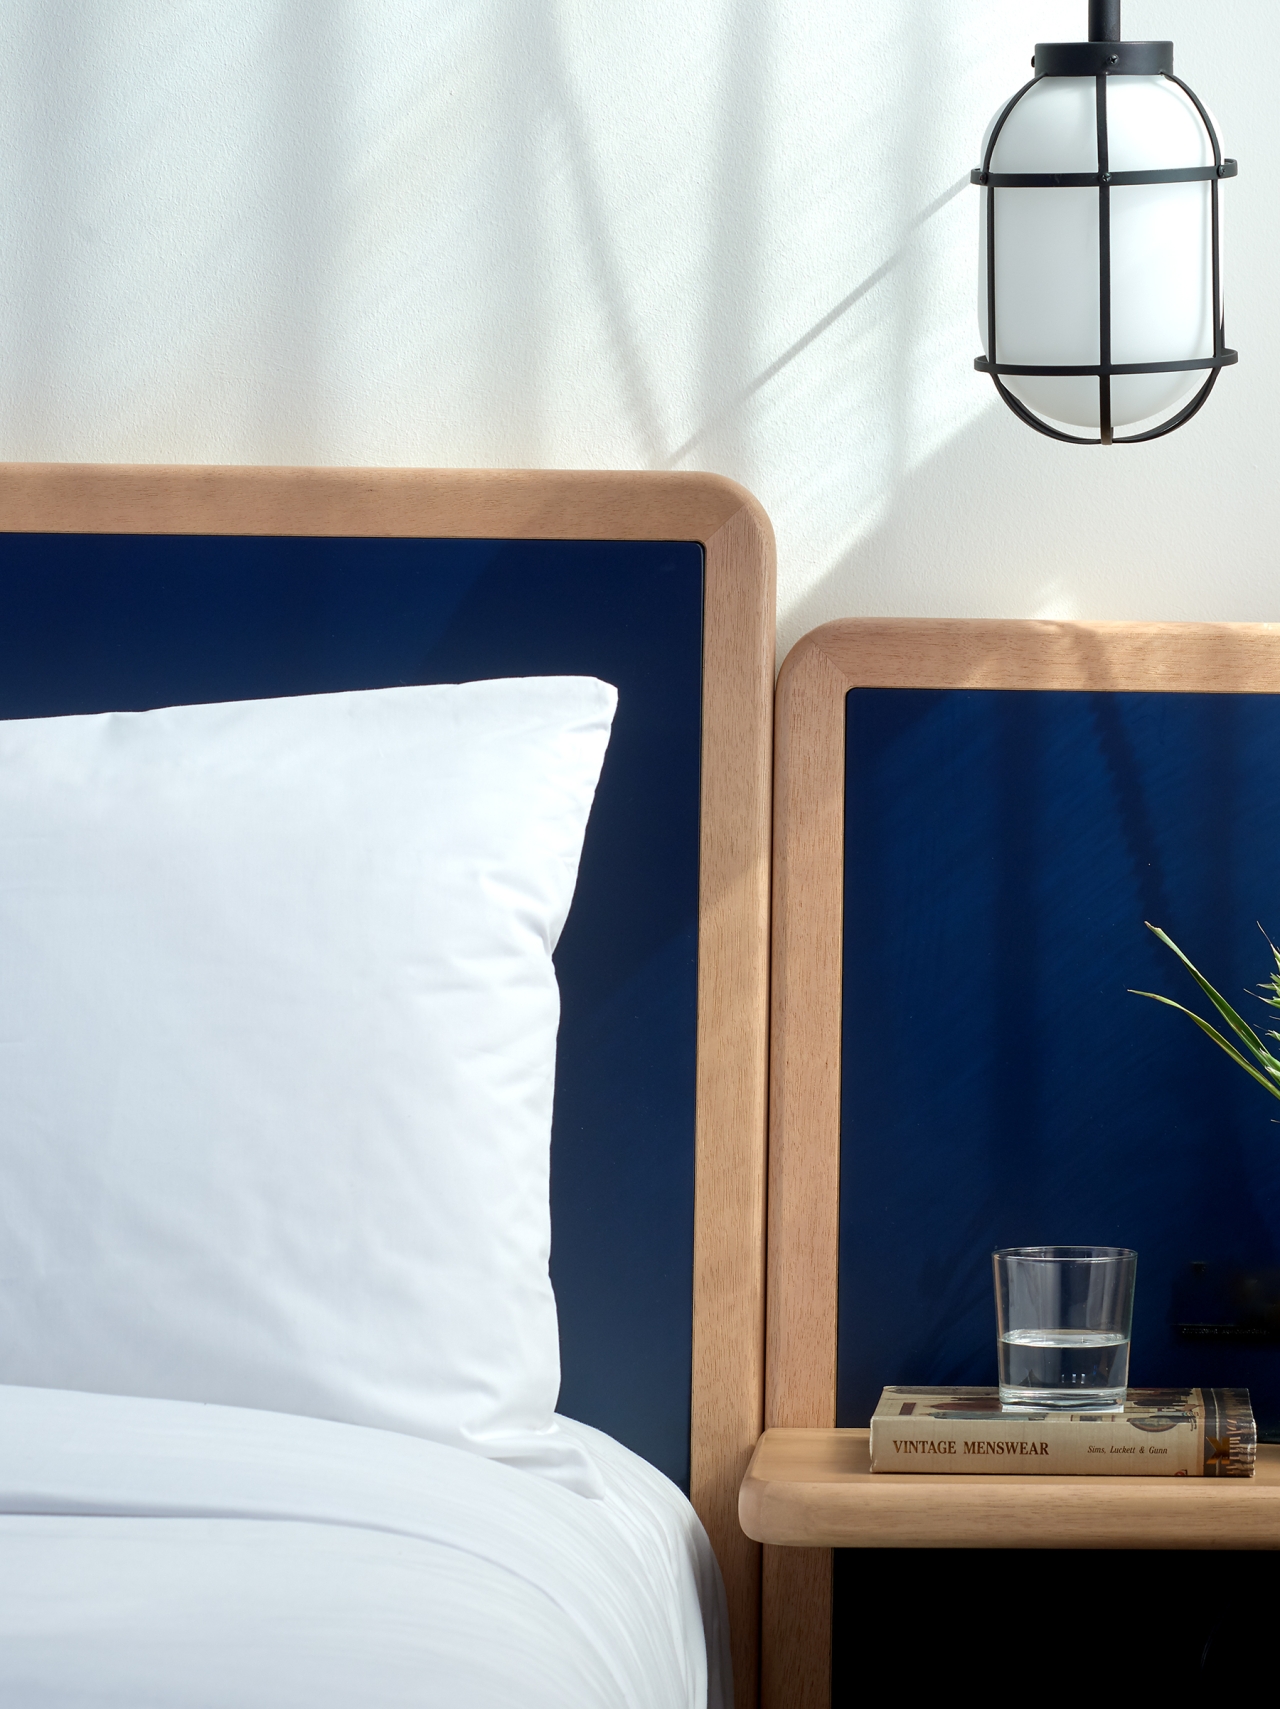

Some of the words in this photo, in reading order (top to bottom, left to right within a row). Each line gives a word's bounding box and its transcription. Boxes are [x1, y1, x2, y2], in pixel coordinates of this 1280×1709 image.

[893, 1440, 957, 1454] VINTAGE
[963, 1441, 1049, 1455] MENSWEAR
[1087, 1445, 1107, 1454] Sims,
[1109, 1445, 1136, 1454] Luckett
[1139, 1446, 1145, 1454] &
[1148, 1446, 1168, 1454] Gunn
